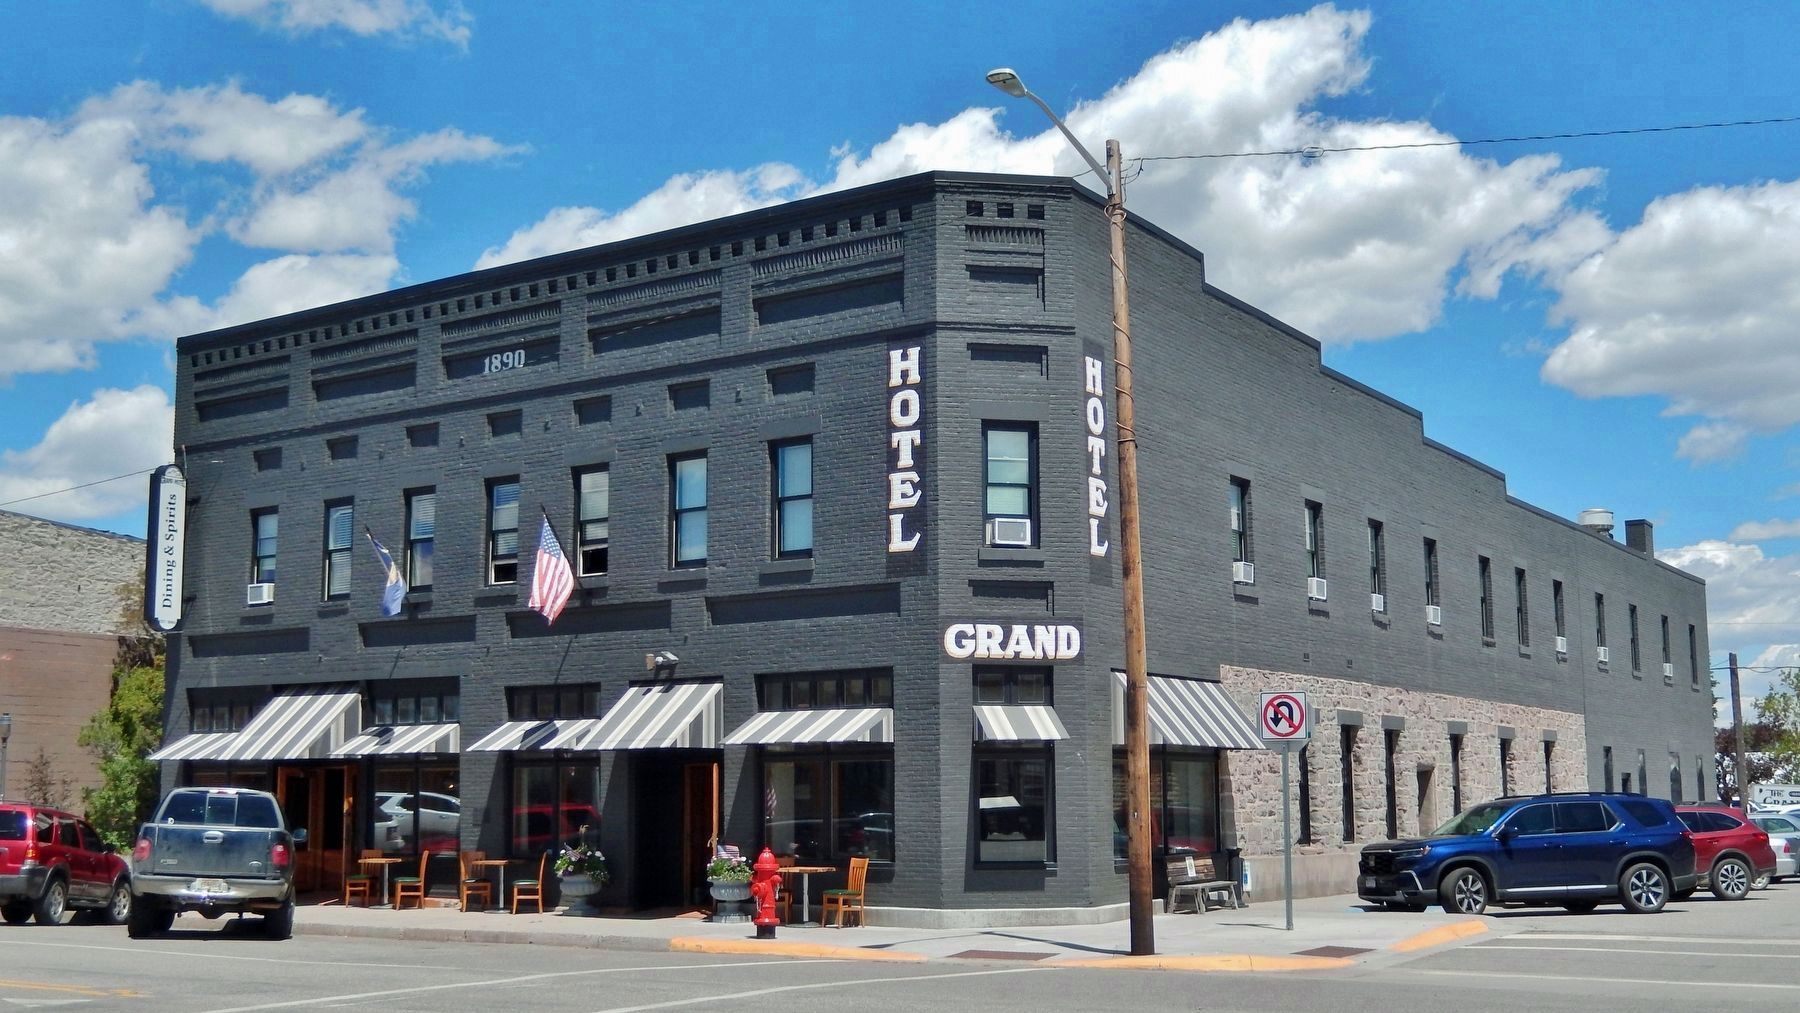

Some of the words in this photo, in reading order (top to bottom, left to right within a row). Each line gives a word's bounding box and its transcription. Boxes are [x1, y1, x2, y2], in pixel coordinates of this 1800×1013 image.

[483, 349, 526, 374] 1890
[888, 347, 921, 553] HOTEL
[1085, 356, 1109, 557] HOTEL
[165, 493, 177, 541] Spirits
[164, 545, 174, 556] &
[162, 559, 176, 609] Dining
[944, 623, 1081, 660] GRAND
